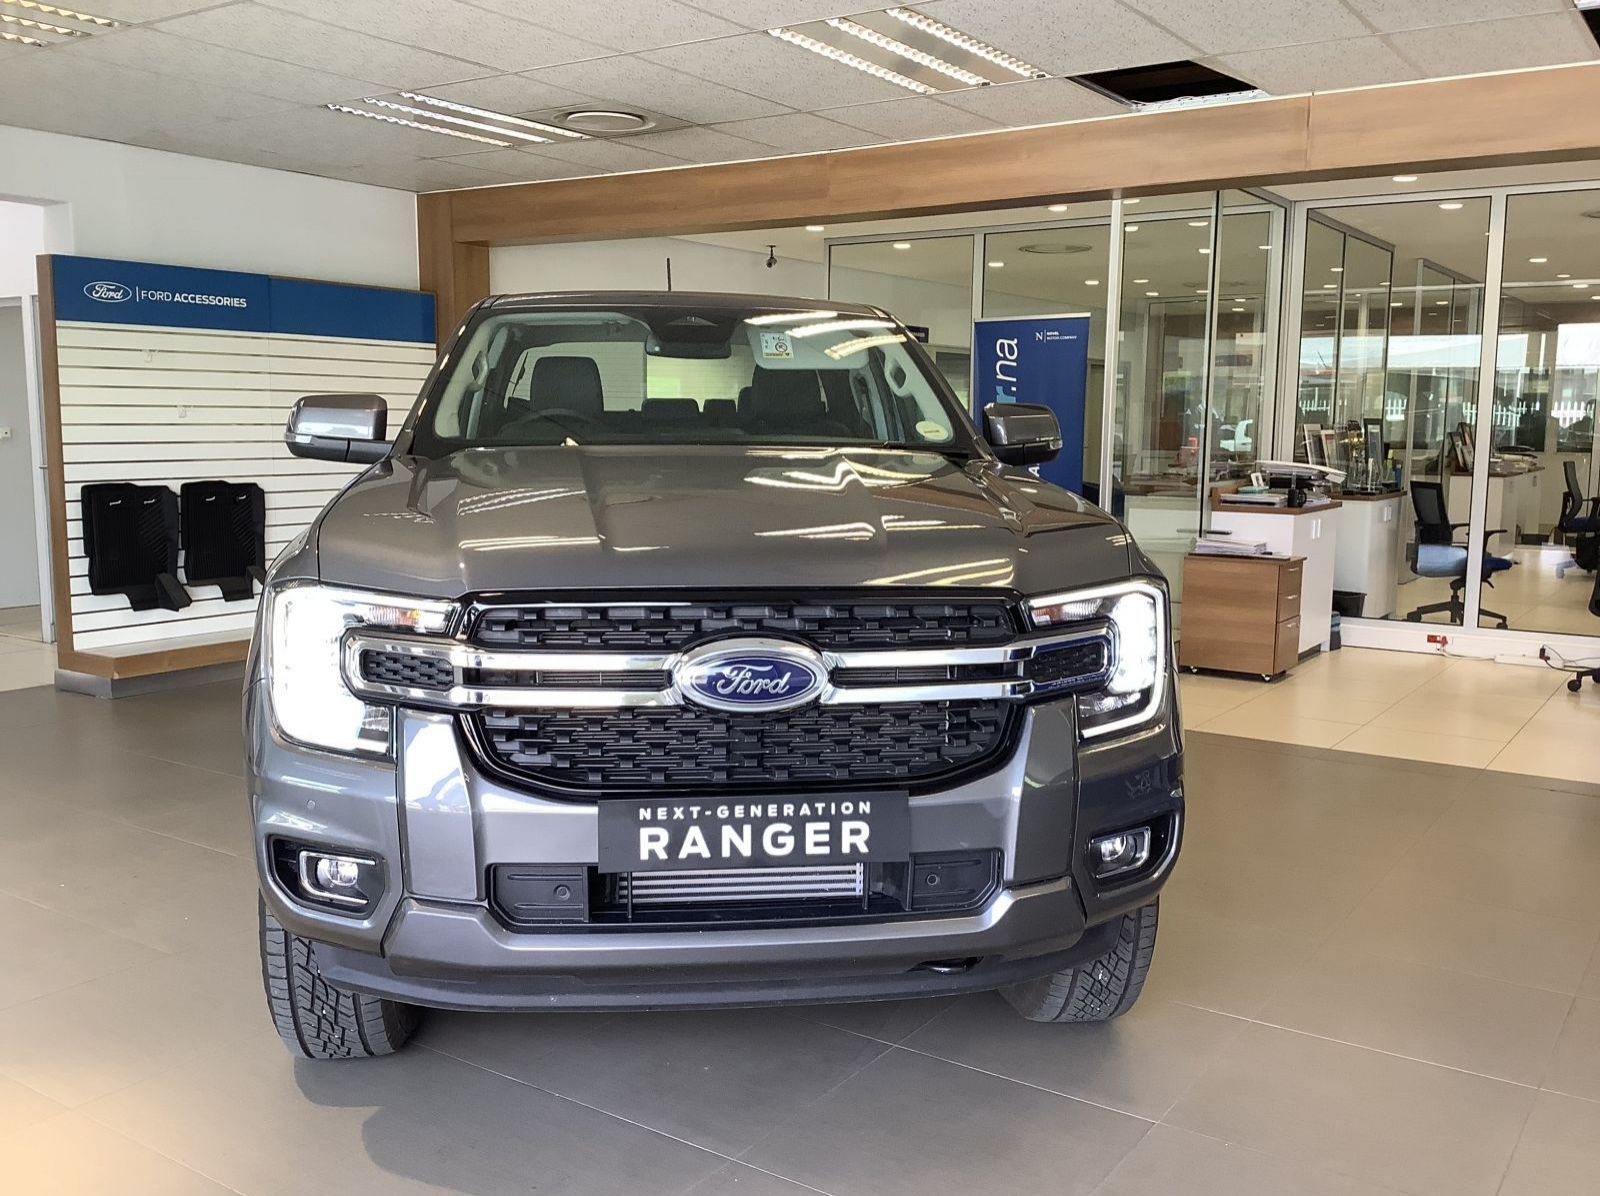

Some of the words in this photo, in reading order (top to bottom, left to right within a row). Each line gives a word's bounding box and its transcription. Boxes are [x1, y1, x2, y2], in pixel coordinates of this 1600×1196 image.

[92, 282, 124, 300] Ford
[141, 290, 172, 302] FORD
[174, 292, 247, 308] ACCESSORIES
[1035, 331, 1043, 341] N
[716, 663, 792, 695] Ford
[639, 801, 871, 821] NEXT-GENERATION
[639, 820, 870, 861] RANGER
